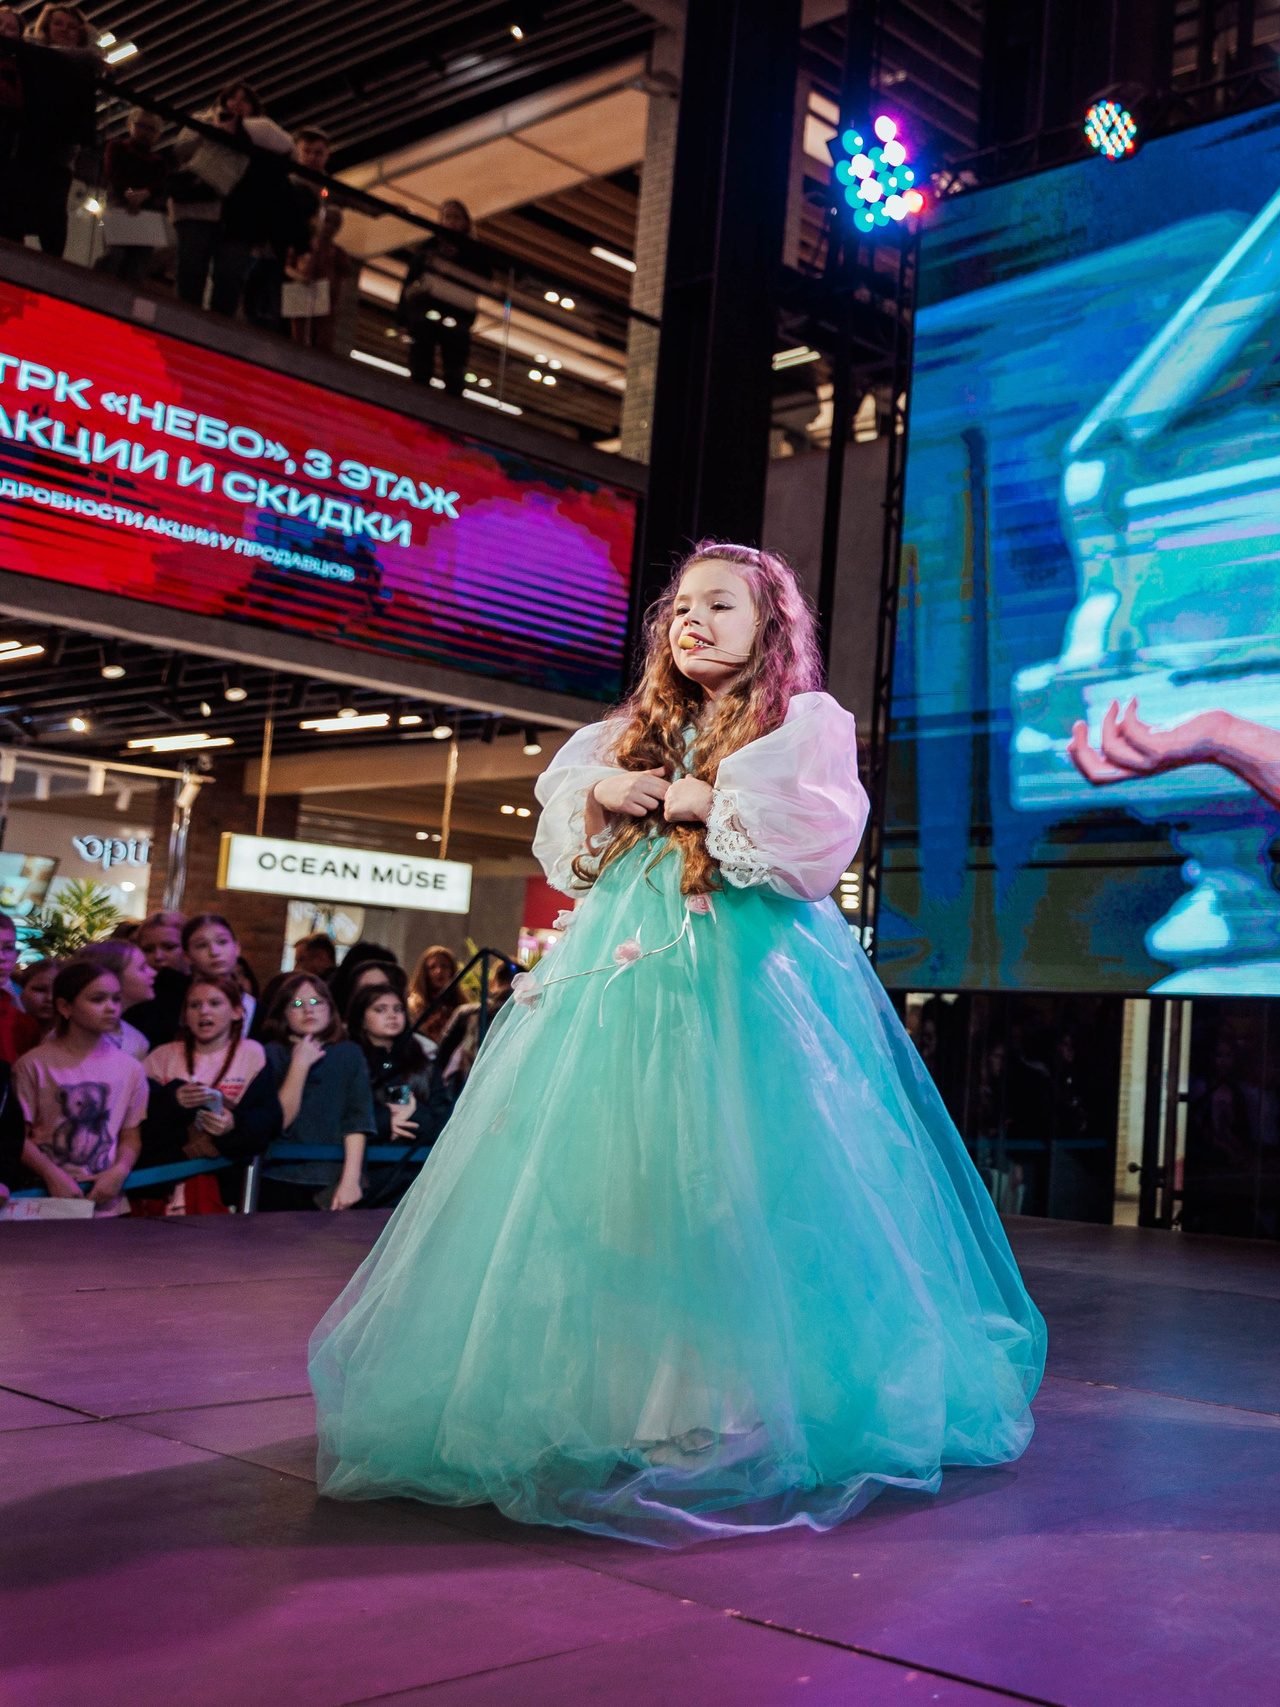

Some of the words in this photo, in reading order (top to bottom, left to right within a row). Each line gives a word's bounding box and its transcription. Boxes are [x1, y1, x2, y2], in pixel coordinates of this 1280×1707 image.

[0, 353, 94, 410] ТРК
[100, 391, 296, 475] «НЕБО»,
[302, 448, 333, 479] 3
[338, 459, 460, 519] ЭТАЖ
[0, 477, 144, 528] ДРОБНОСТИ
[220, 533, 235, 550] У
[177, 456, 216, 493] И
[222, 470, 412, 548] СКИДКИ
[258, 852, 360, 881] OCEAN
